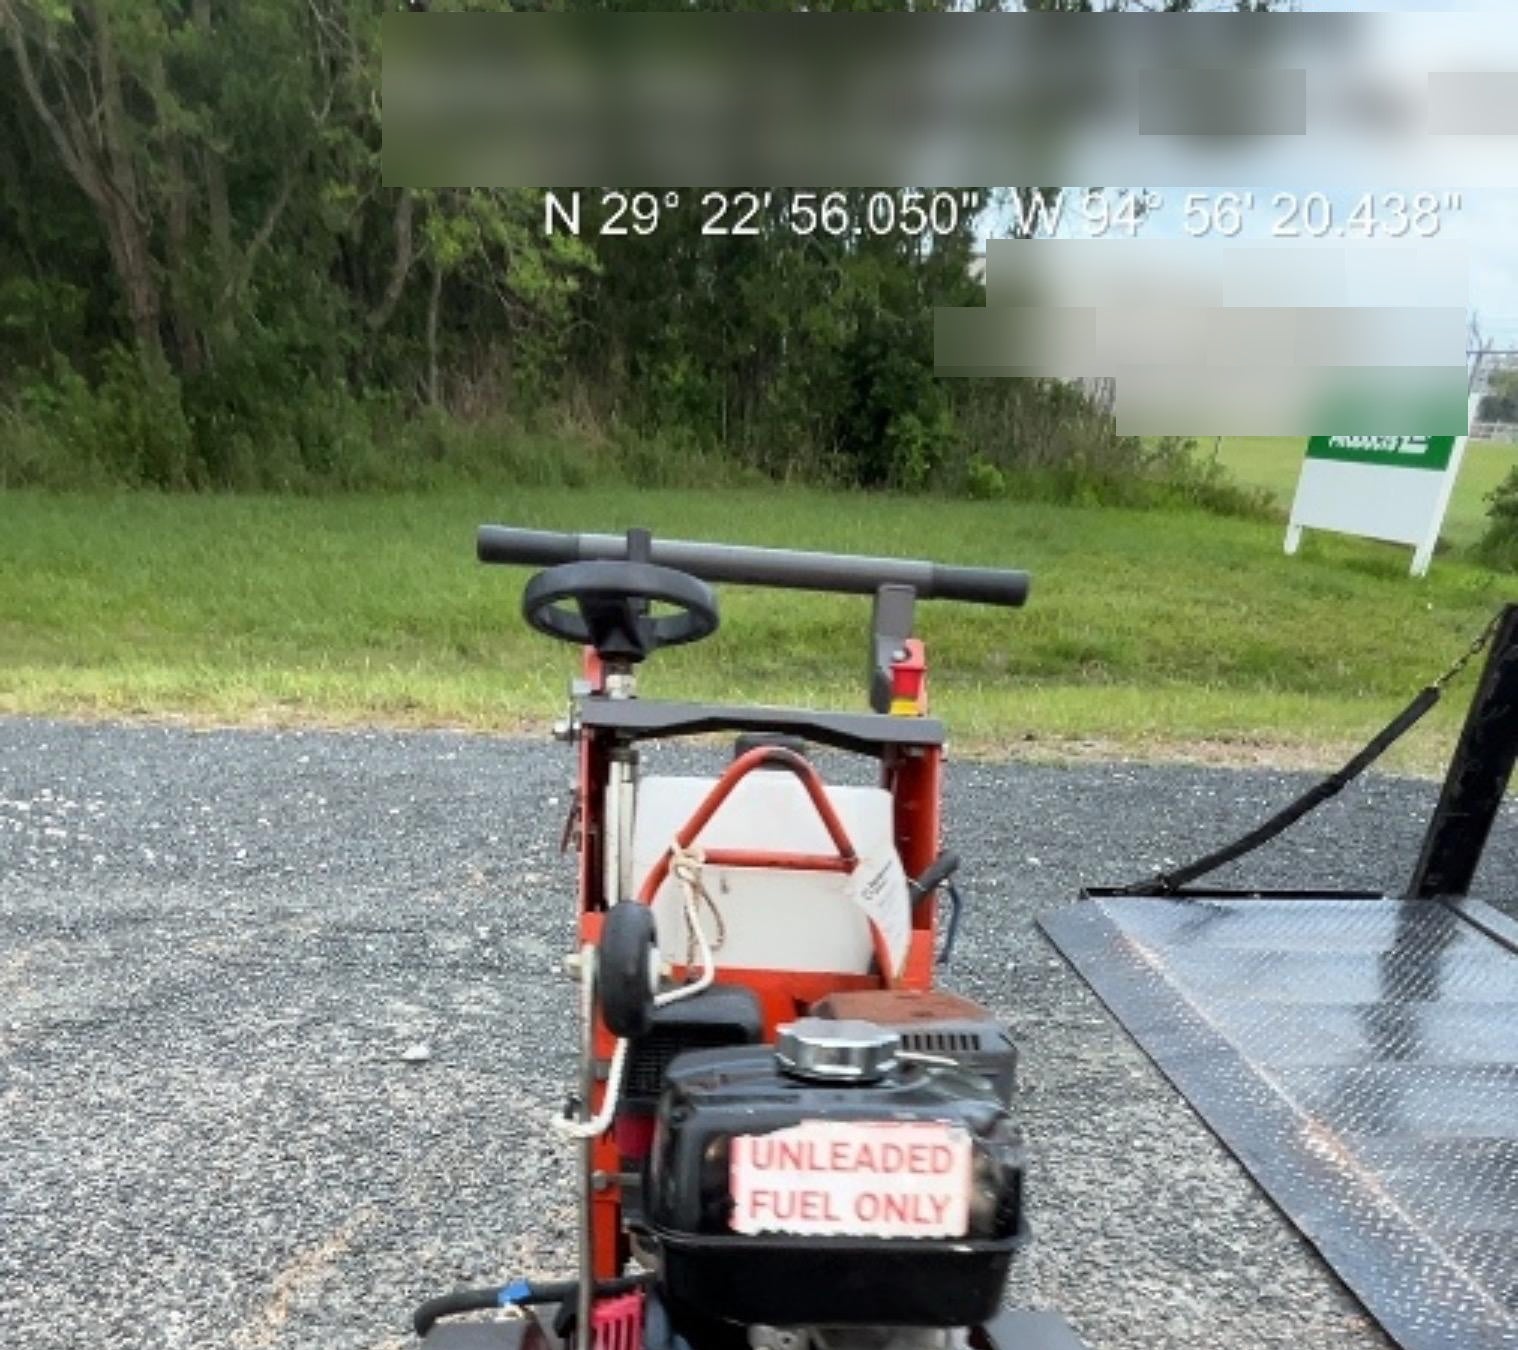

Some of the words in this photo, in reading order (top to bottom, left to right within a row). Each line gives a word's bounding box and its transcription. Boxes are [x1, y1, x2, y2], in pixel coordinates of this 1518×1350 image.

[750, 1140, 954, 1174] UNLEADED
[749, 1189, 841, 1222] FUEL
[854, 1193, 951, 1225] ONLY
